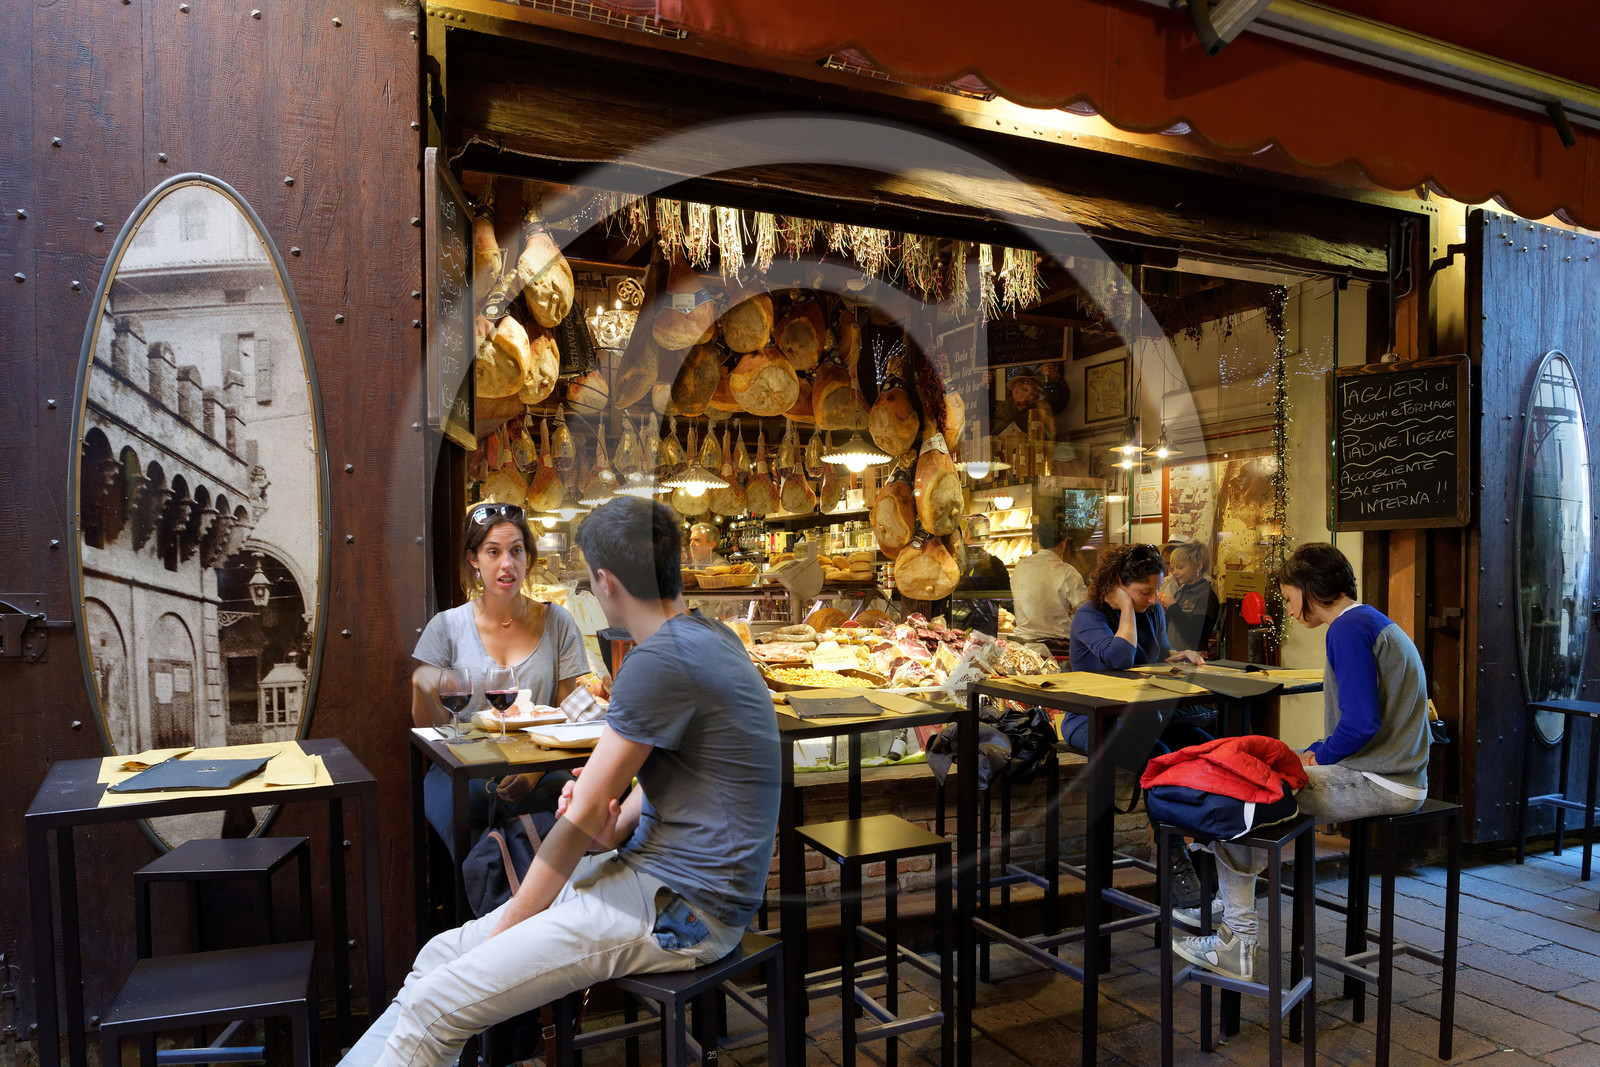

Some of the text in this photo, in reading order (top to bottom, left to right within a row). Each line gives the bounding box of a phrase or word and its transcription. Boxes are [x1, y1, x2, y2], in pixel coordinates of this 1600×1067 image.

[441, 323, 463, 352] ASAGNE
[565, 312, 579, 367] STRAVECC
[441, 355, 460, 375] OSETTE
[1339, 377, 1448, 407] TAGLIERI di
[1342, 399, 1456, 427] SALUMI e FORMAGGI
[1398, 425, 1455, 446] TIGELLE
[1341, 459, 1438, 487] ACCOGLIENTE
[1340, 479, 1407, 500] SALETTA
[1361, 492, 1430, 514] INTERNA
[707, 1050, 718, 1061] 25
